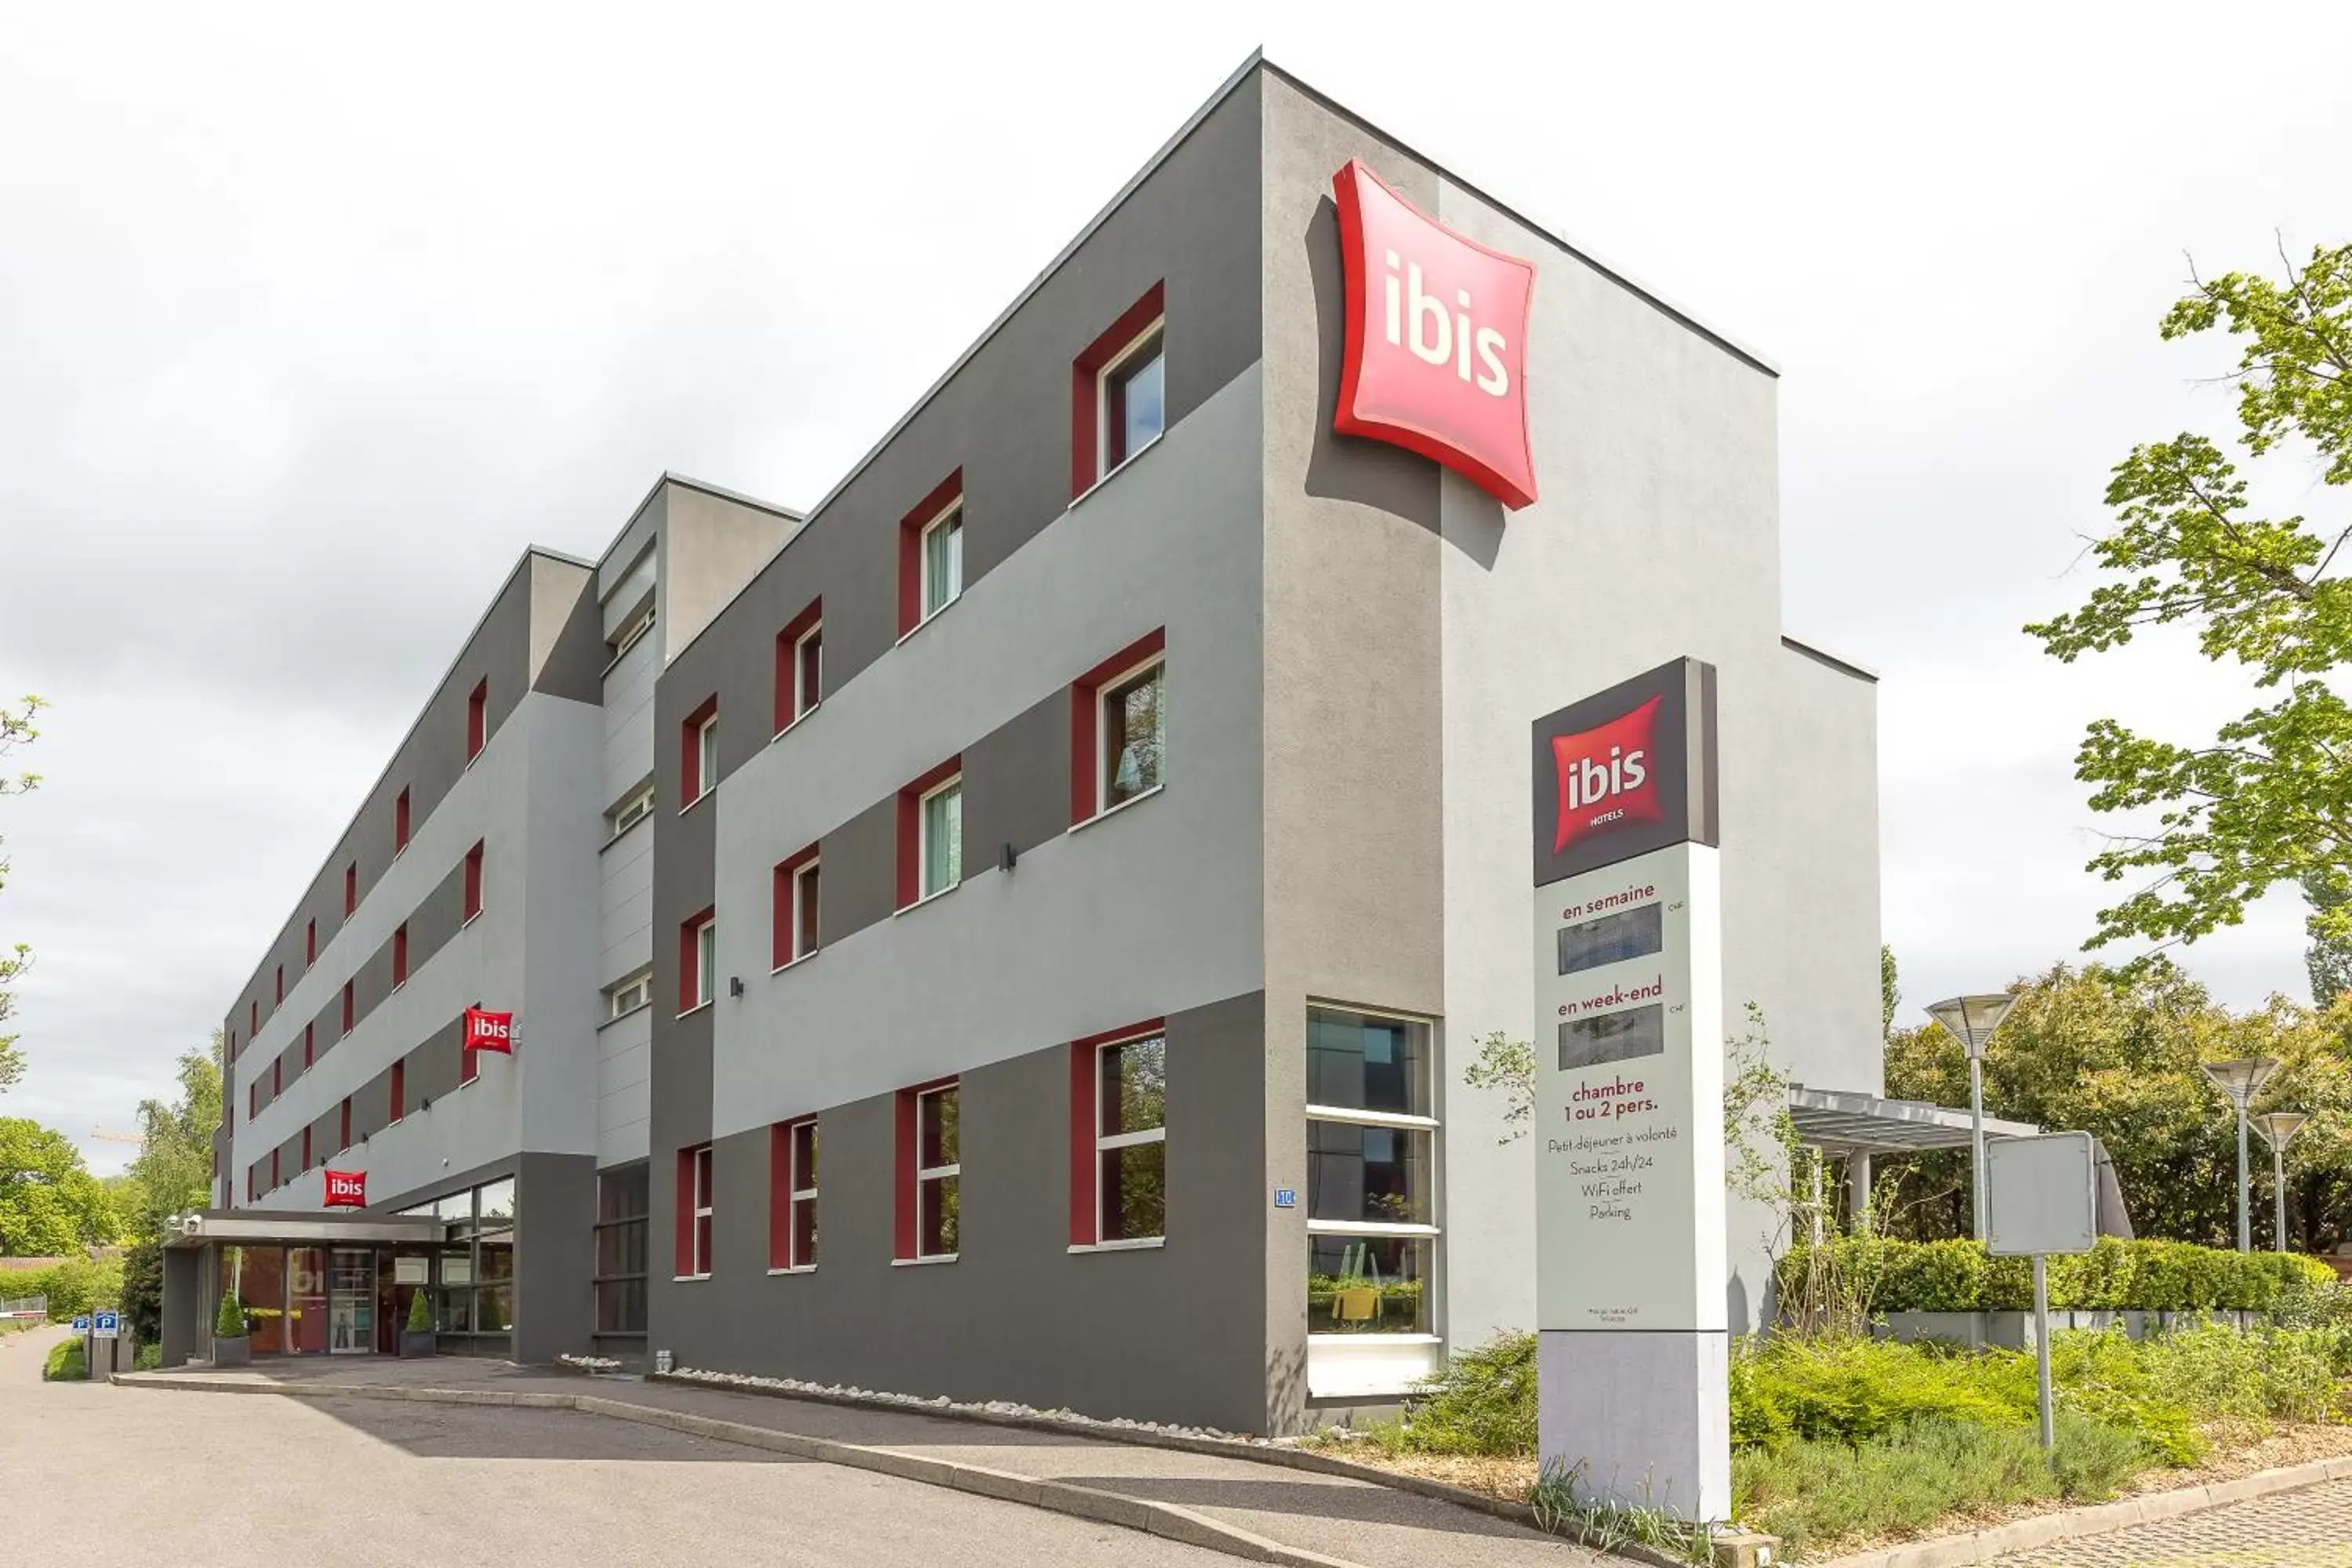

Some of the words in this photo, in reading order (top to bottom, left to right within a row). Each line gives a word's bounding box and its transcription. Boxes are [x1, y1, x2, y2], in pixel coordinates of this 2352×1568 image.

[1385, 248, 1509, 397] ibis
[1568, 746, 1646, 810] ibis
[1590, 808, 1624, 826] HOTELS
[1563, 905, 1581, 920] en
[1586, 884, 1654, 913] semaine
[1558, 1003, 1577, 1015] en
[1582, 973, 1662, 1009] week-end
[474, 1017, 507, 1039] ibis
[1572, 1075, 1643, 1102] chambre
[1565, 1106, 1570, 1122] 1
[1575, 1108, 1595, 1120] ou
[1600, 1101, 1611, 1116] 2
[1616, 1099, 1658, 1121] pers.
[1626, 1133, 1633, 1144] à
[1636, 1125, 1677, 1142] volonté
[1570, 1159, 1607, 1175] Snacks
[1611, 1154, 1653, 1172] 24h/24
[332, 1178, 362, 1196] ibis
[1581, 1181, 1610, 1197] WiFi
[1612, 1179, 1642, 1196] offert
[1590, 1204, 1632, 1221] Parking
[102, 1319, 111, 1330] P
